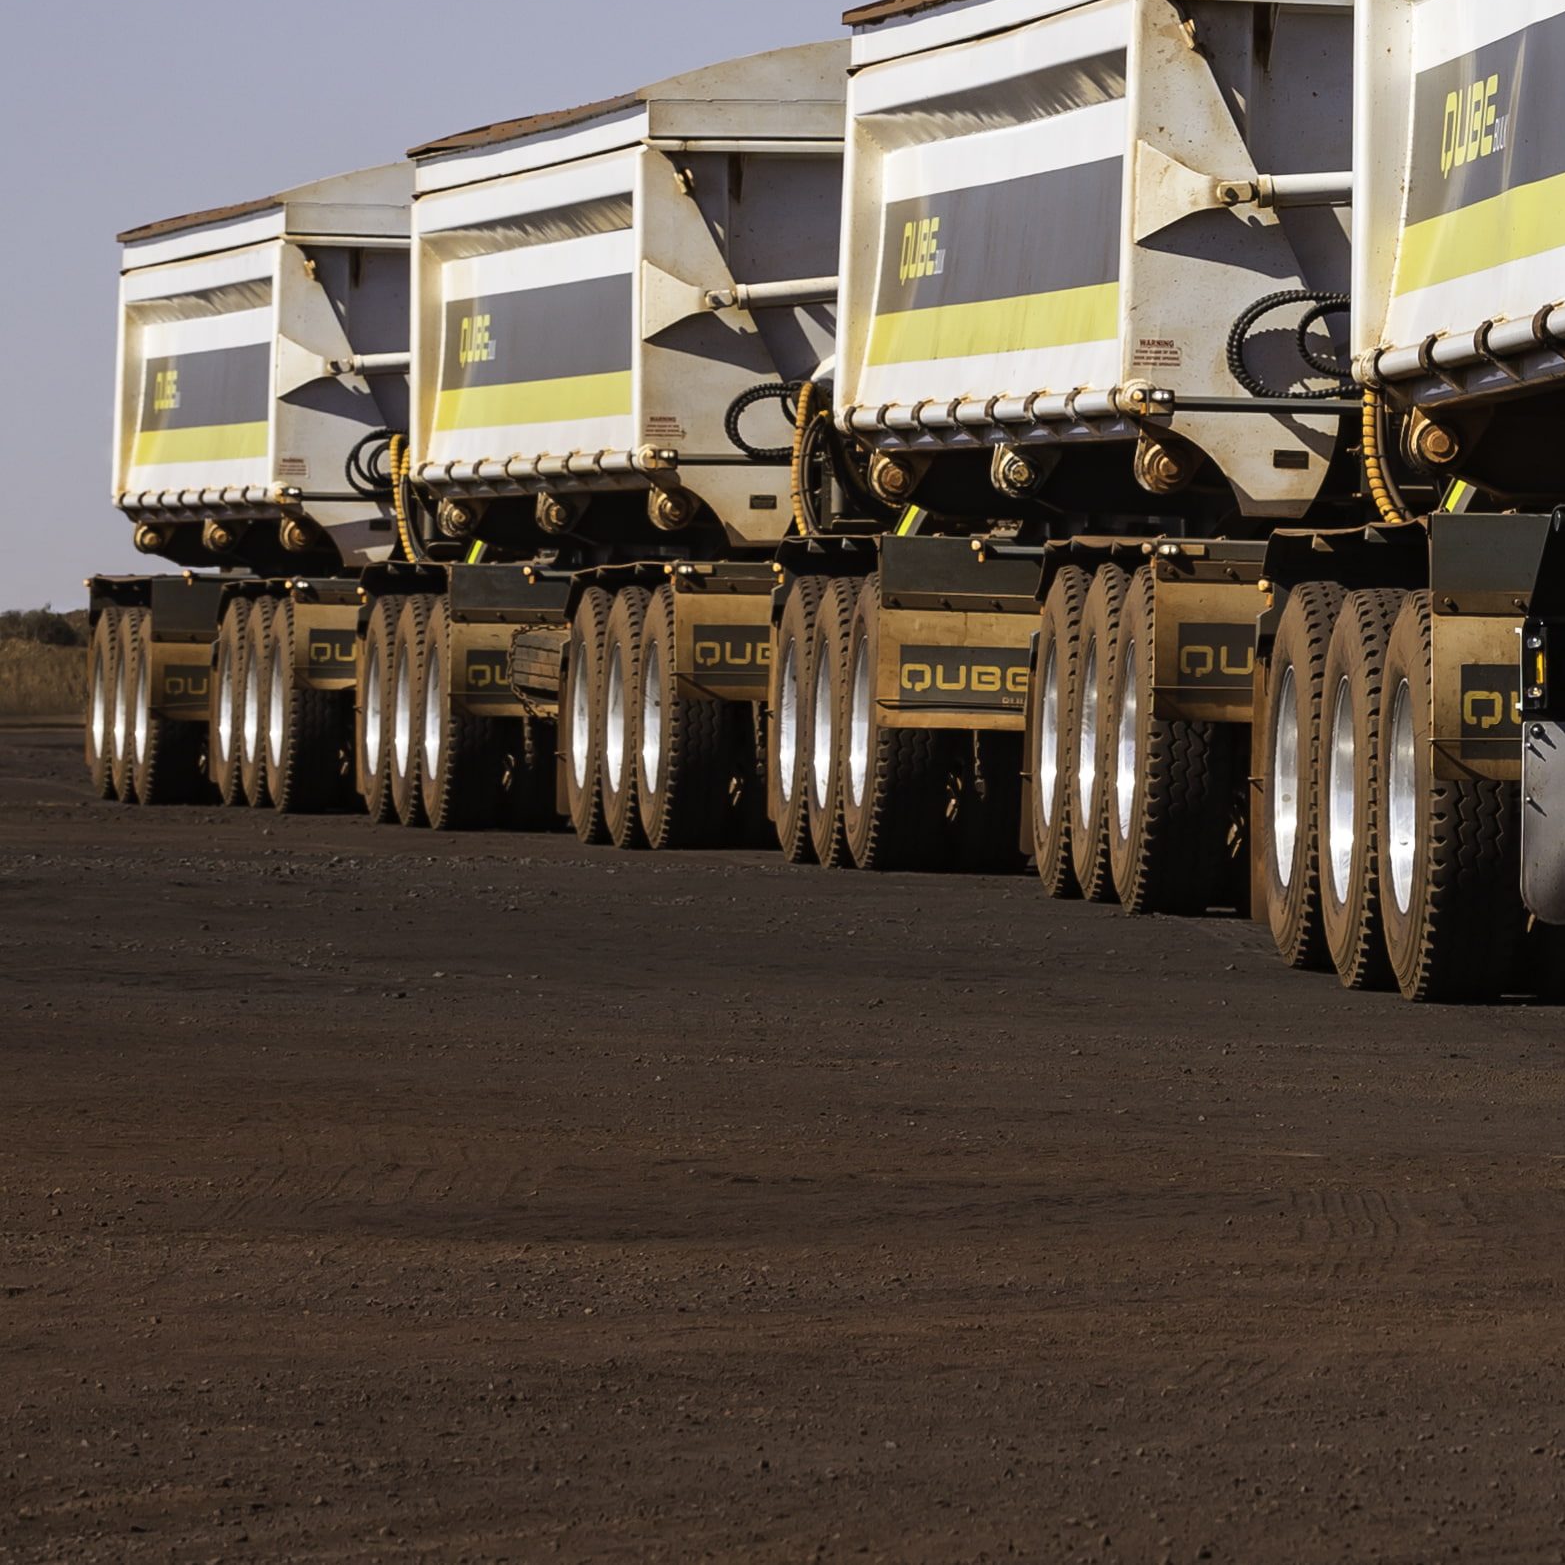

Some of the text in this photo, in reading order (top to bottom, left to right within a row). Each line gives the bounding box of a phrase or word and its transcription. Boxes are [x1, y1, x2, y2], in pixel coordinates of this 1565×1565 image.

[1441, 74, 1498, 179] QUBE
[900, 217, 940, 286] QUBE
[310, 642, 357, 662] QU
[695, 641, 770, 667] QUB
[1180, 645, 1255, 677] QU
[165, 677, 208, 695] QU
[901, 663, 1029, 692] QUBE
